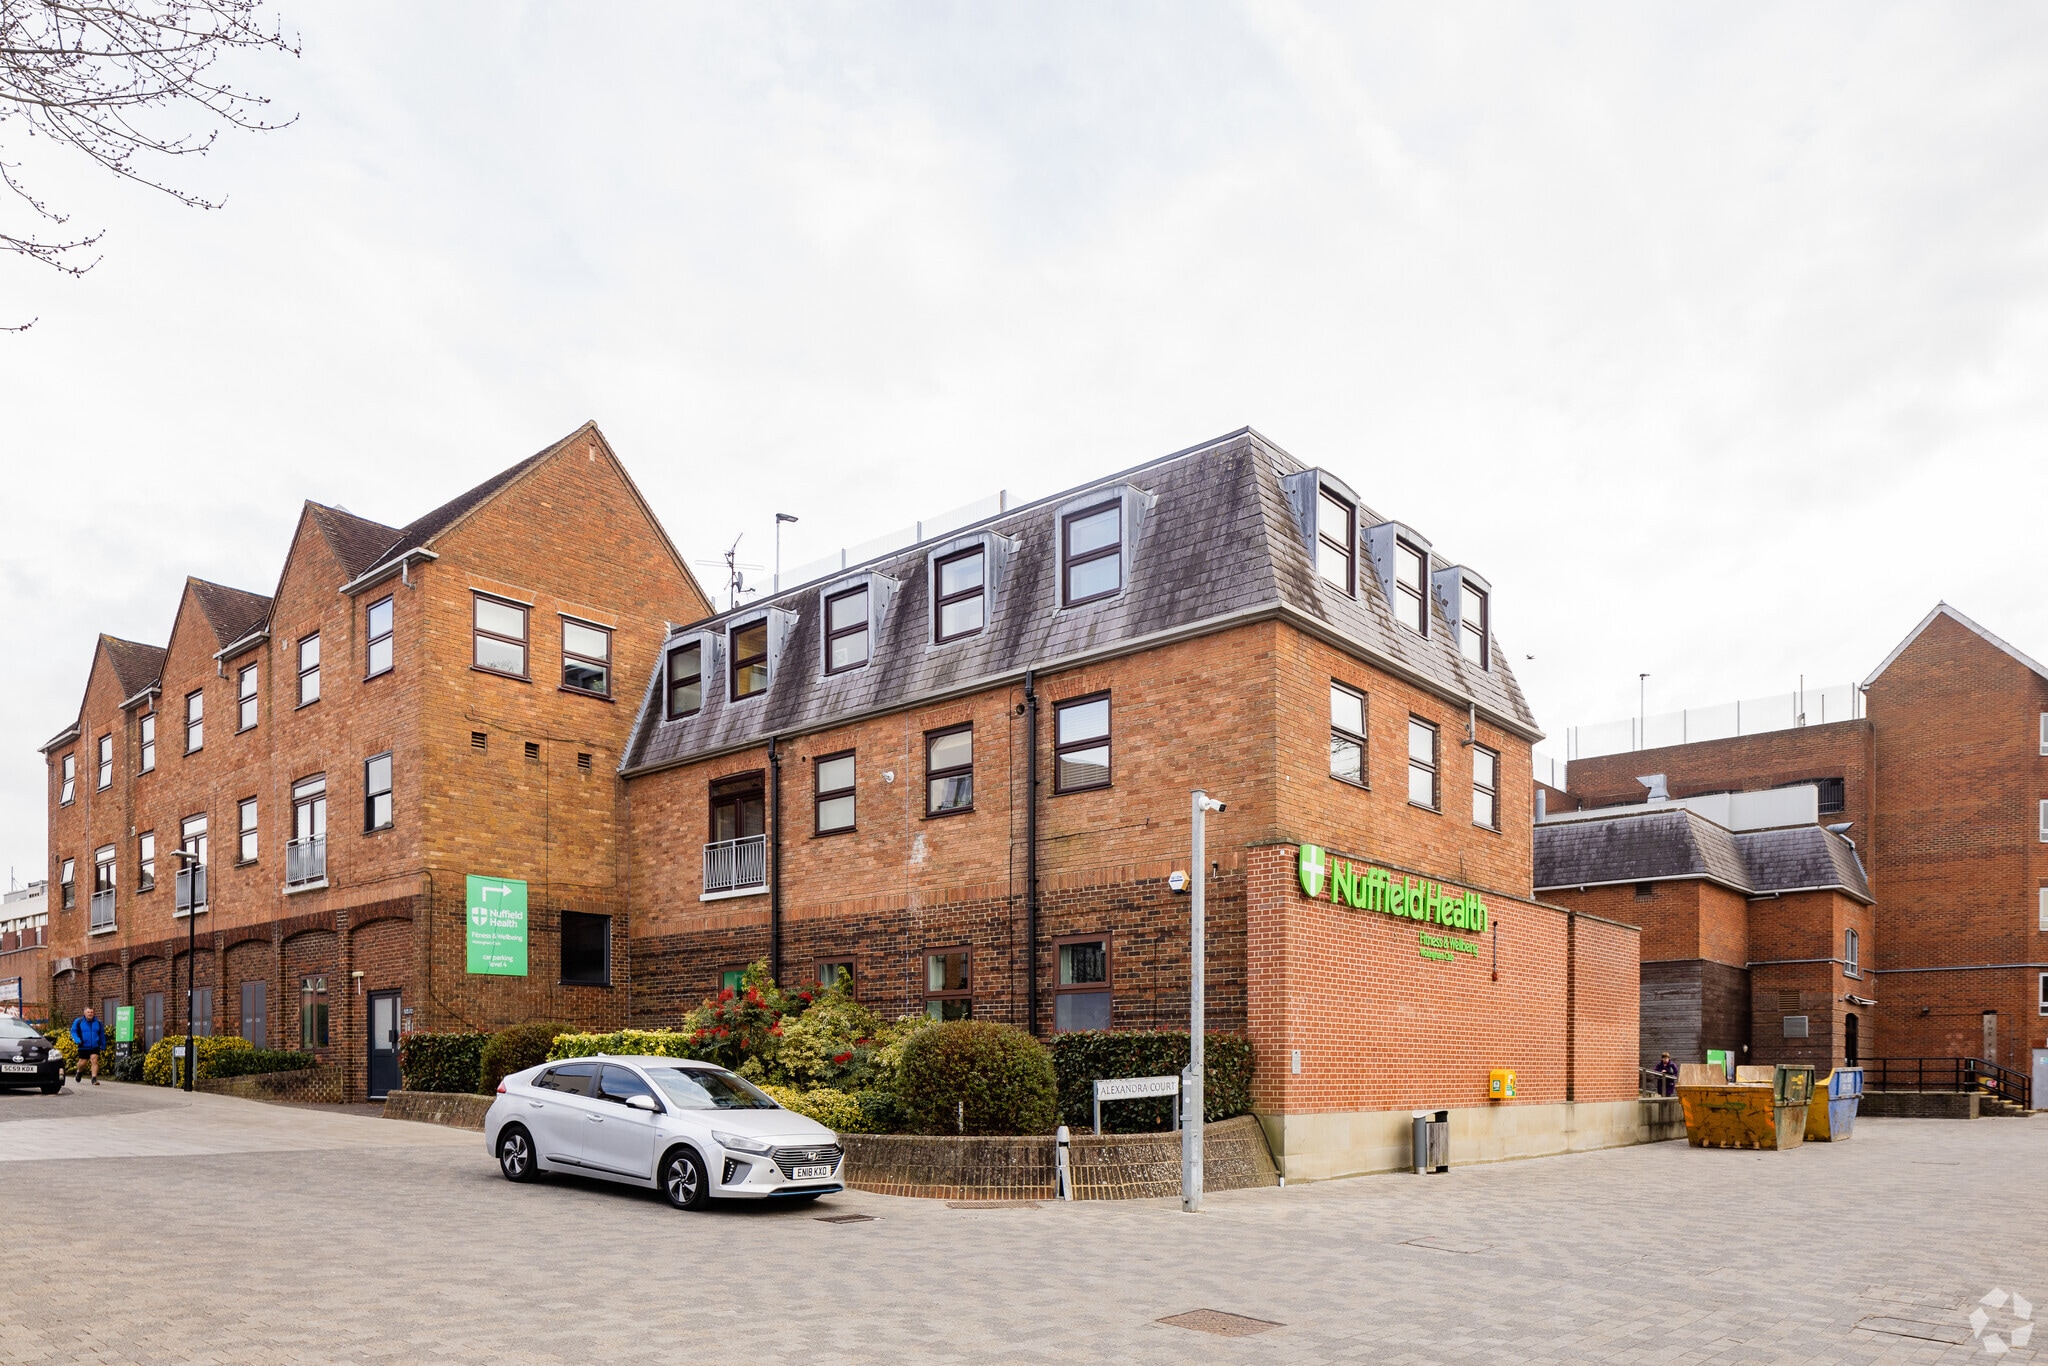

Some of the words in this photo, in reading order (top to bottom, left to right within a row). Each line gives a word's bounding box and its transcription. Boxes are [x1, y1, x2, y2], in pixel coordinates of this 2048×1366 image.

[490, 909, 523, 919] Nuffield
[490, 918, 517, 927] Health
[497, 934, 523, 942] Wellbeing
[1419, 931, 1443, 948] Fitness
[1443, 935, 1449, 949] &
[1100, 1083, 1148, 1095] ALEXANDRA
[1150, 1081, 1176, 1092] COURT
[798, 1168, 812, 1177] EN18
